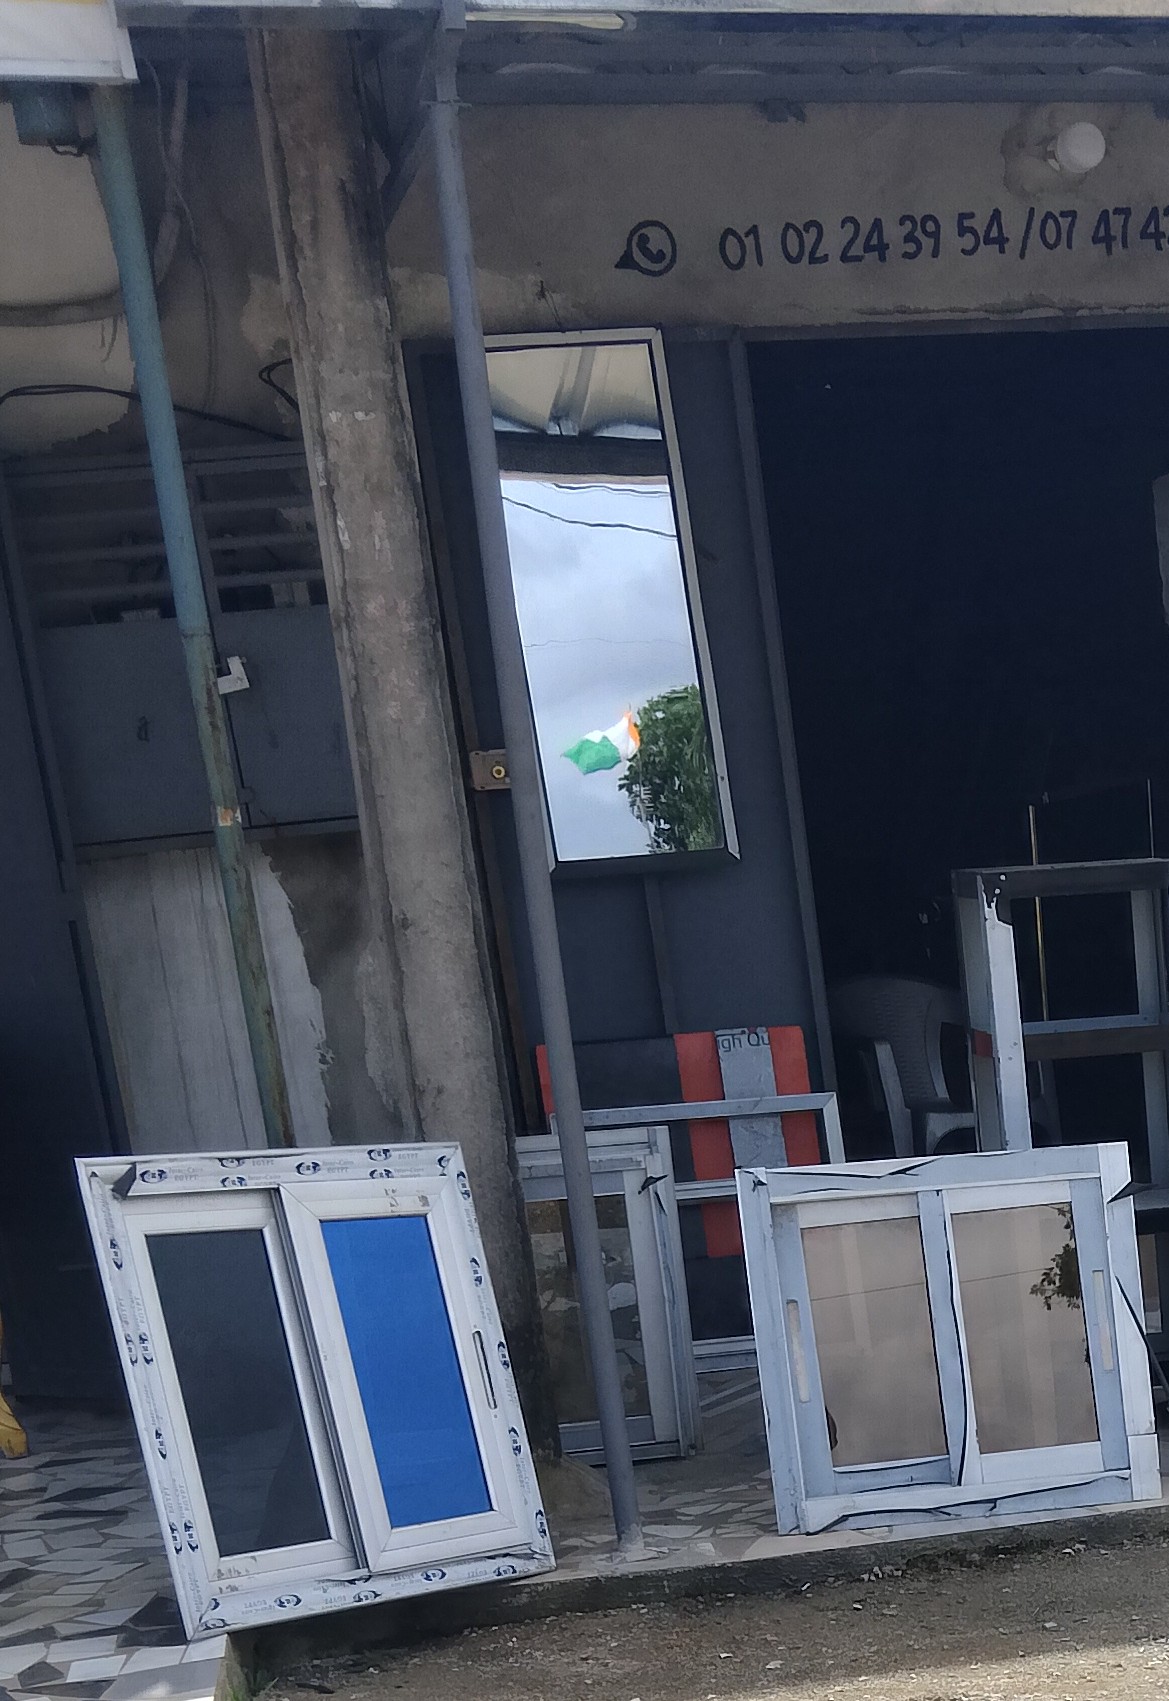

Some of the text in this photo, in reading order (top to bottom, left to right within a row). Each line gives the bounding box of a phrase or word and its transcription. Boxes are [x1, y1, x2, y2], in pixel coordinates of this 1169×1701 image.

[719, 226, 764, 271] 01
[781, 219, 829, 265] 02
[840, 215, 890, 263] 24
[899, 213, 942, 260] 39
[1091, 206, 1132, 256] 47
